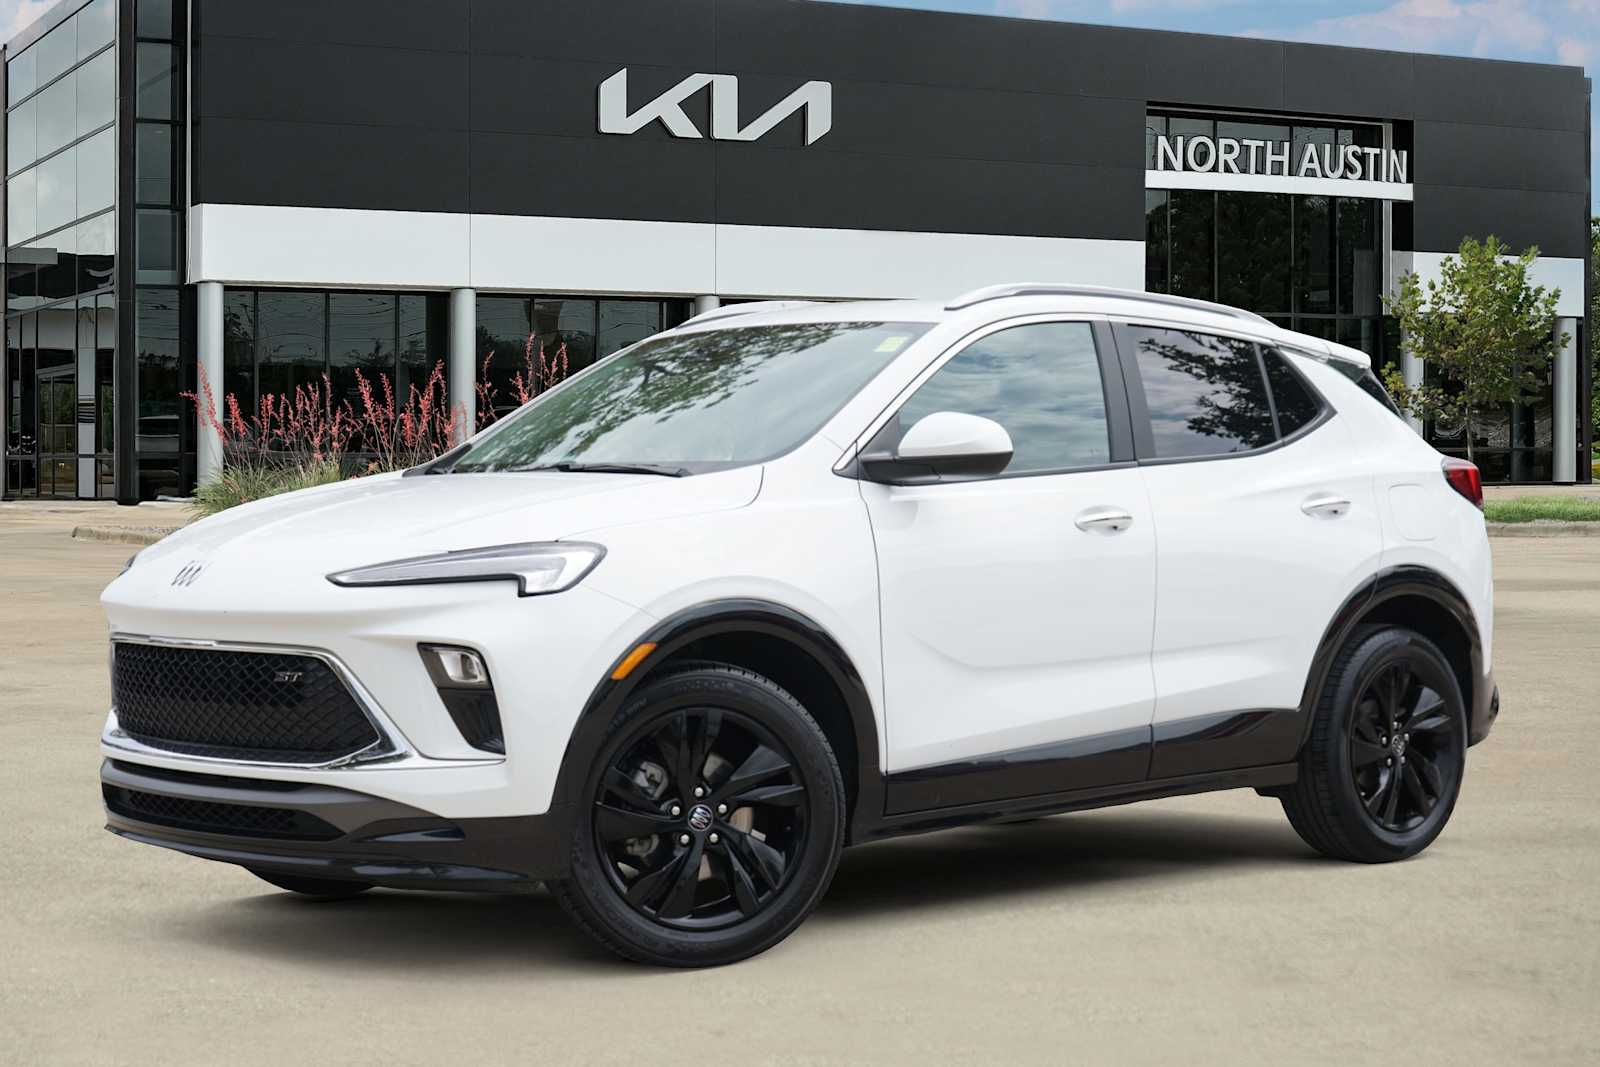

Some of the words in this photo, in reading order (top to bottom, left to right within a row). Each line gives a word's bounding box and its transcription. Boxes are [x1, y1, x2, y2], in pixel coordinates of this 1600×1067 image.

[598, 67, 832, 146] KIA
[1157, 135, 1291, 176] NORTH
[1298, 143, 1408, 184] AUSTIN
[274, 672, 303, 682] ST
